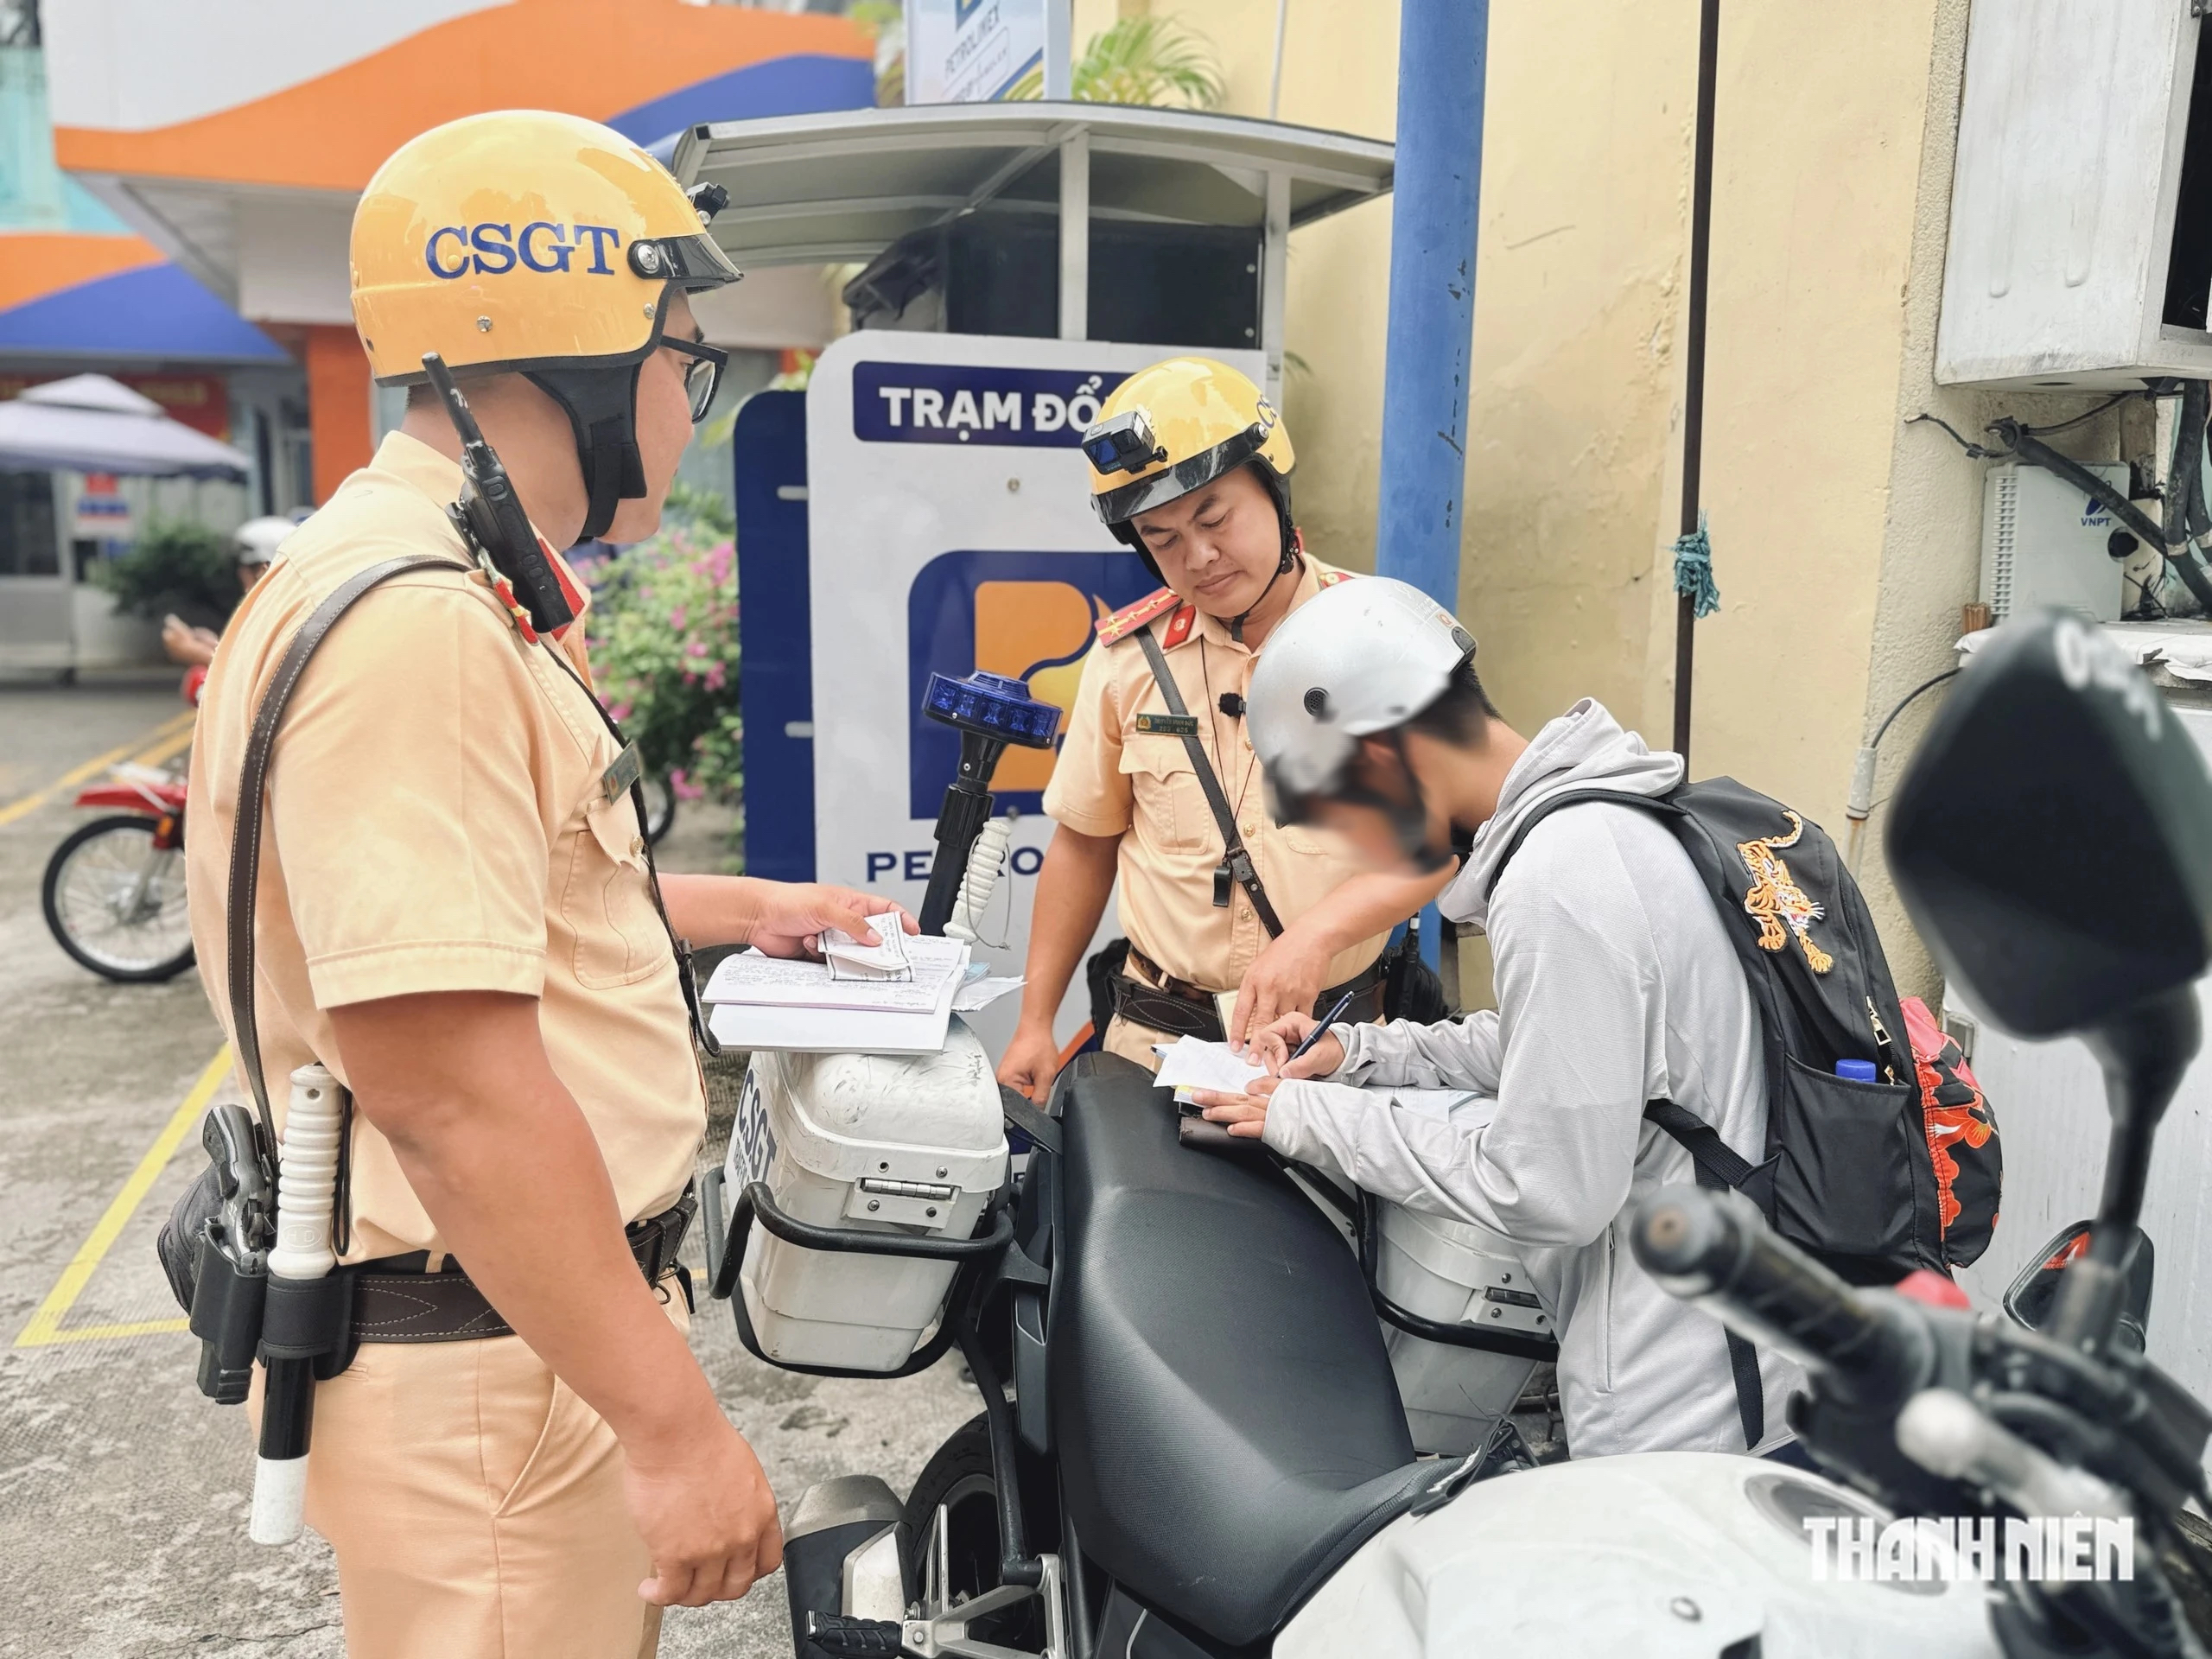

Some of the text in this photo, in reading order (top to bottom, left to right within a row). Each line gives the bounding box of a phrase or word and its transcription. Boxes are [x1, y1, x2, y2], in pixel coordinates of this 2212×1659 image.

[425, 221, 620, 279] CSGT
[879, 375, 1109, 442] TRẠM ĐỔ
[2081, 518, 2111, 526] VNPT
